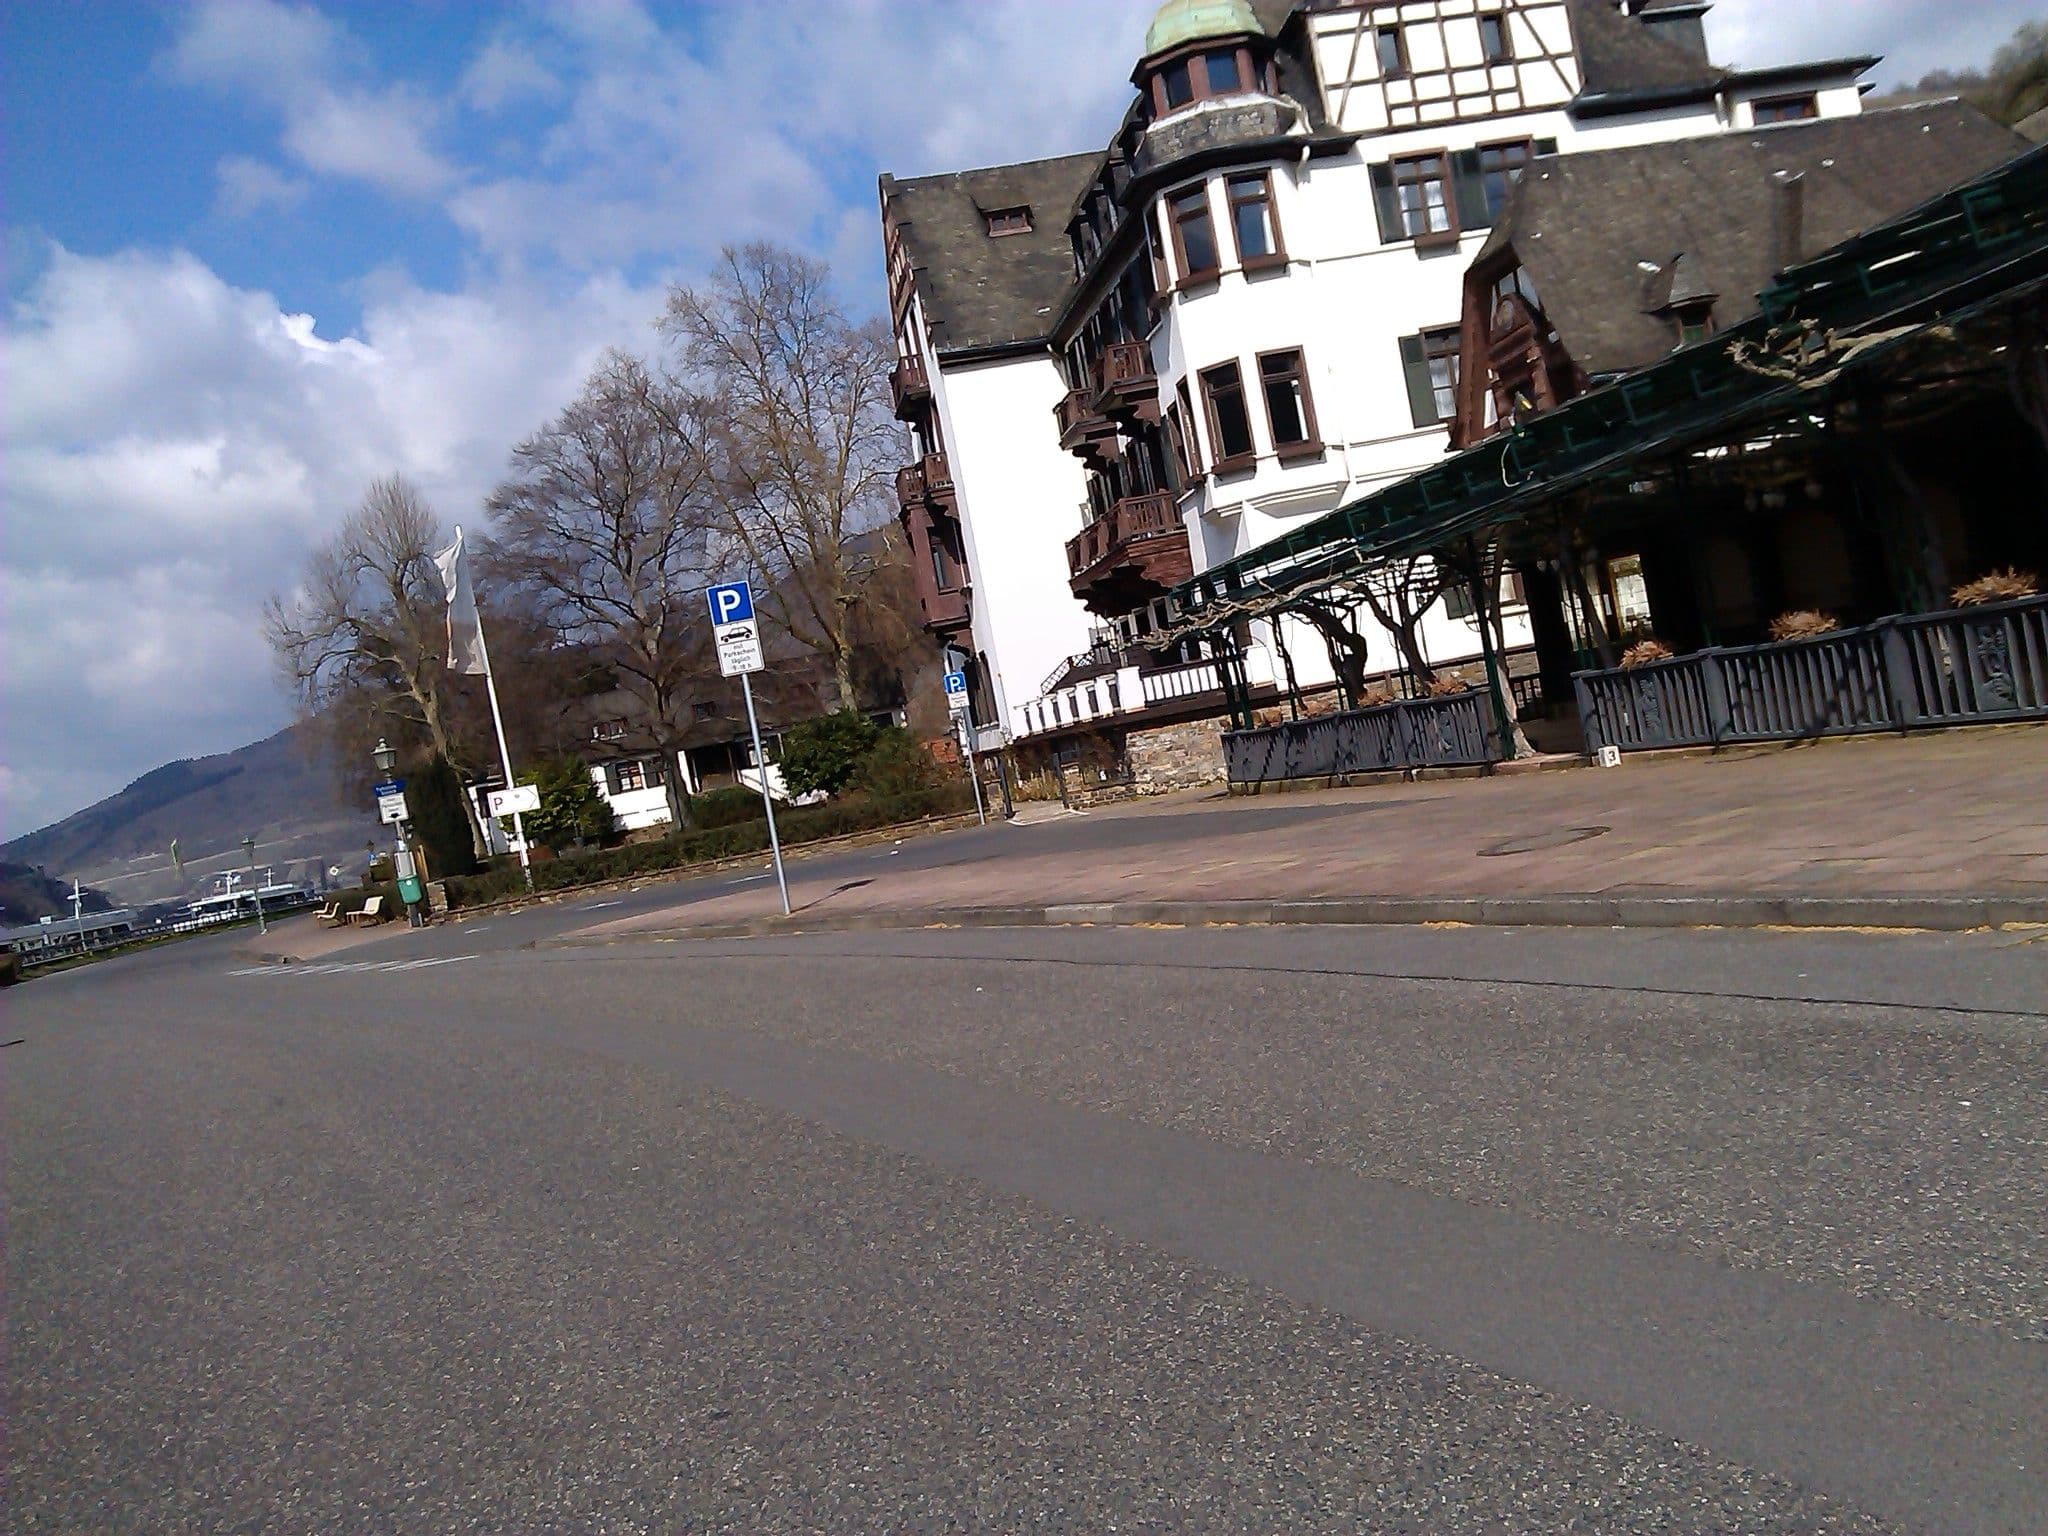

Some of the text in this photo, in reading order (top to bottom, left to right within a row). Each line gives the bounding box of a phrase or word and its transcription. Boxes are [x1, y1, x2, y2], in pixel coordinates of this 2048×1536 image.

[717, 589, 741, 623] P
[949, 676, 961, 693] P
[1608, 750, 1617, 761] 3
[494, 797, 503, 810] P
